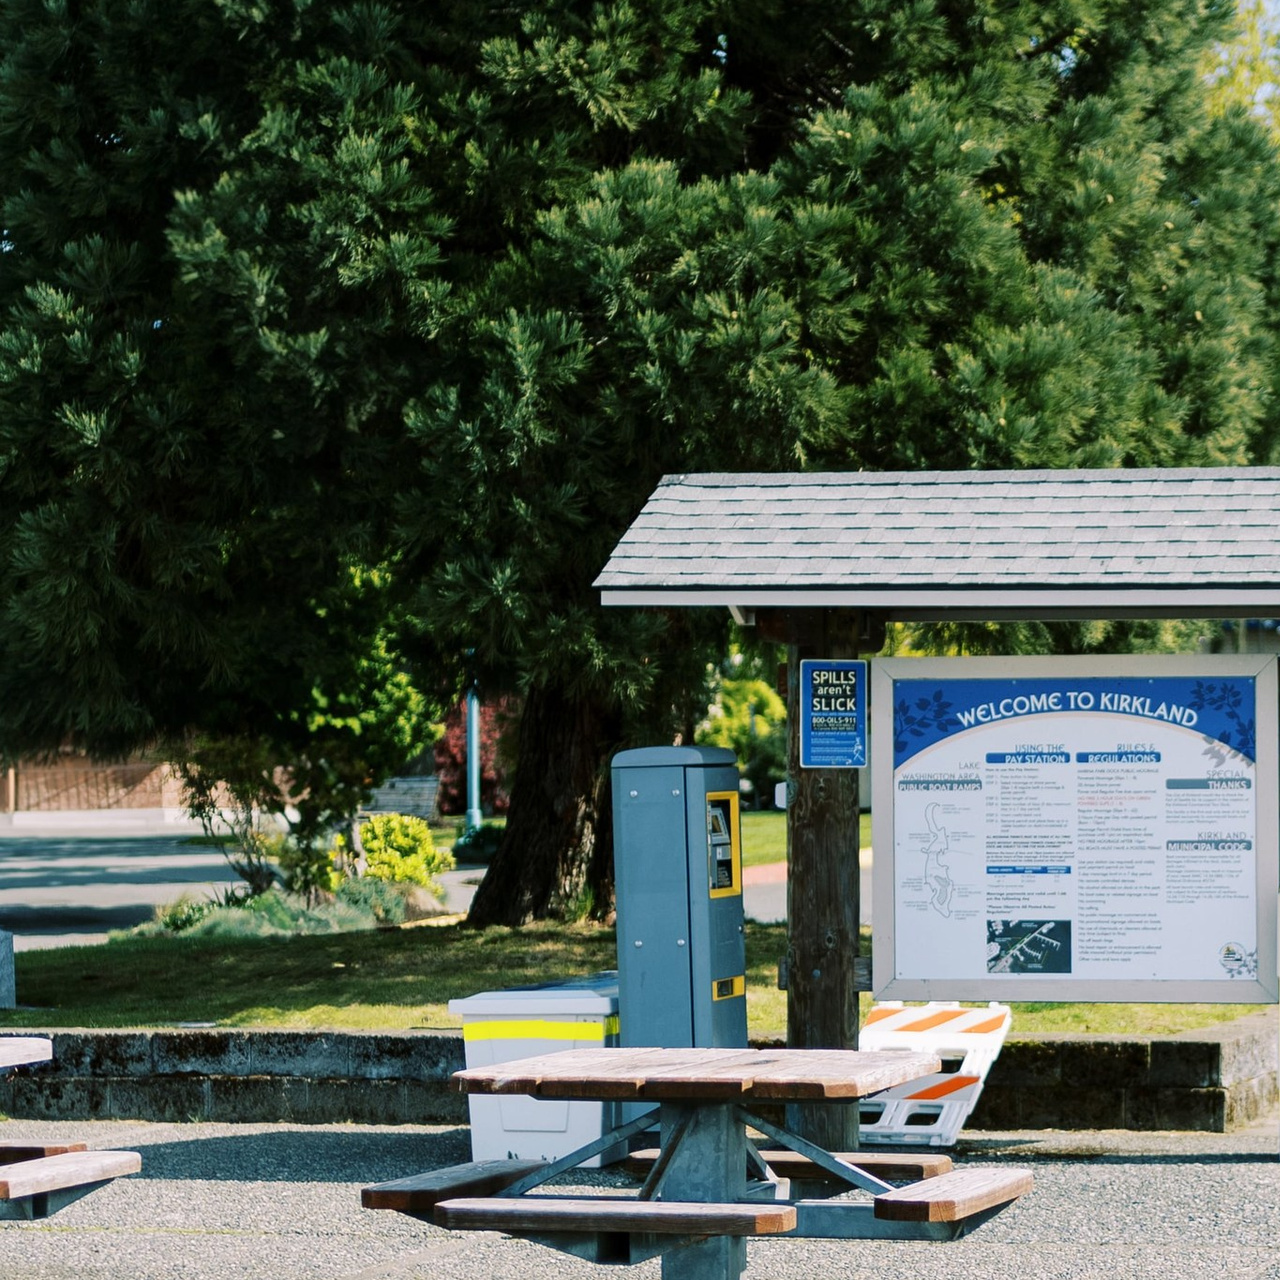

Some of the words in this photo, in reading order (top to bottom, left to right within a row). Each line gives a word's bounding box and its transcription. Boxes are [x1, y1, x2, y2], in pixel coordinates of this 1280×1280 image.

[812, 671, 856, 684] SPILLS
[817, 685, 851, 695] aren't
[812, 698, 856, 711] SLICK
[956, 692, 1062, 727] WELCOME
[1066, 691, 1095, 709] TO
[1100, 692, 1198, 727] KIRKLAND
[812, 716, 856, 724] 800-OILS-911
[1015, 744, 1043, 753] USING
[1046, 744, 1065, 753] THE
[1117, 743, 1146, 752] RULES
[1149, 743, 1155, 752] &
[1005, 754, 1023, 763] PAY
[1025, 754, 1065, 763] STATION
[1088, 754, 1156, 763] REGULATIONS
[959, 762, 980, 770] LAKE
[902, 773, 955, 781] WASHINGTON
[958, 773, 980, 781] AREA
[1206, 770, 1246, 779] SPECIAL
[900, 783, 928, 791] PUBLIC
[930, 783, 951, 791] BOAT
[953, 783, 981, 791] RAMPS
[1207, 781, 1247, 790] THANKS
[1197, 832, 1247, 841] KIRKLAND
[1168, 842, 1215, 851] MUNICIPAL
[1218, 842, 1247, 851] CODE
